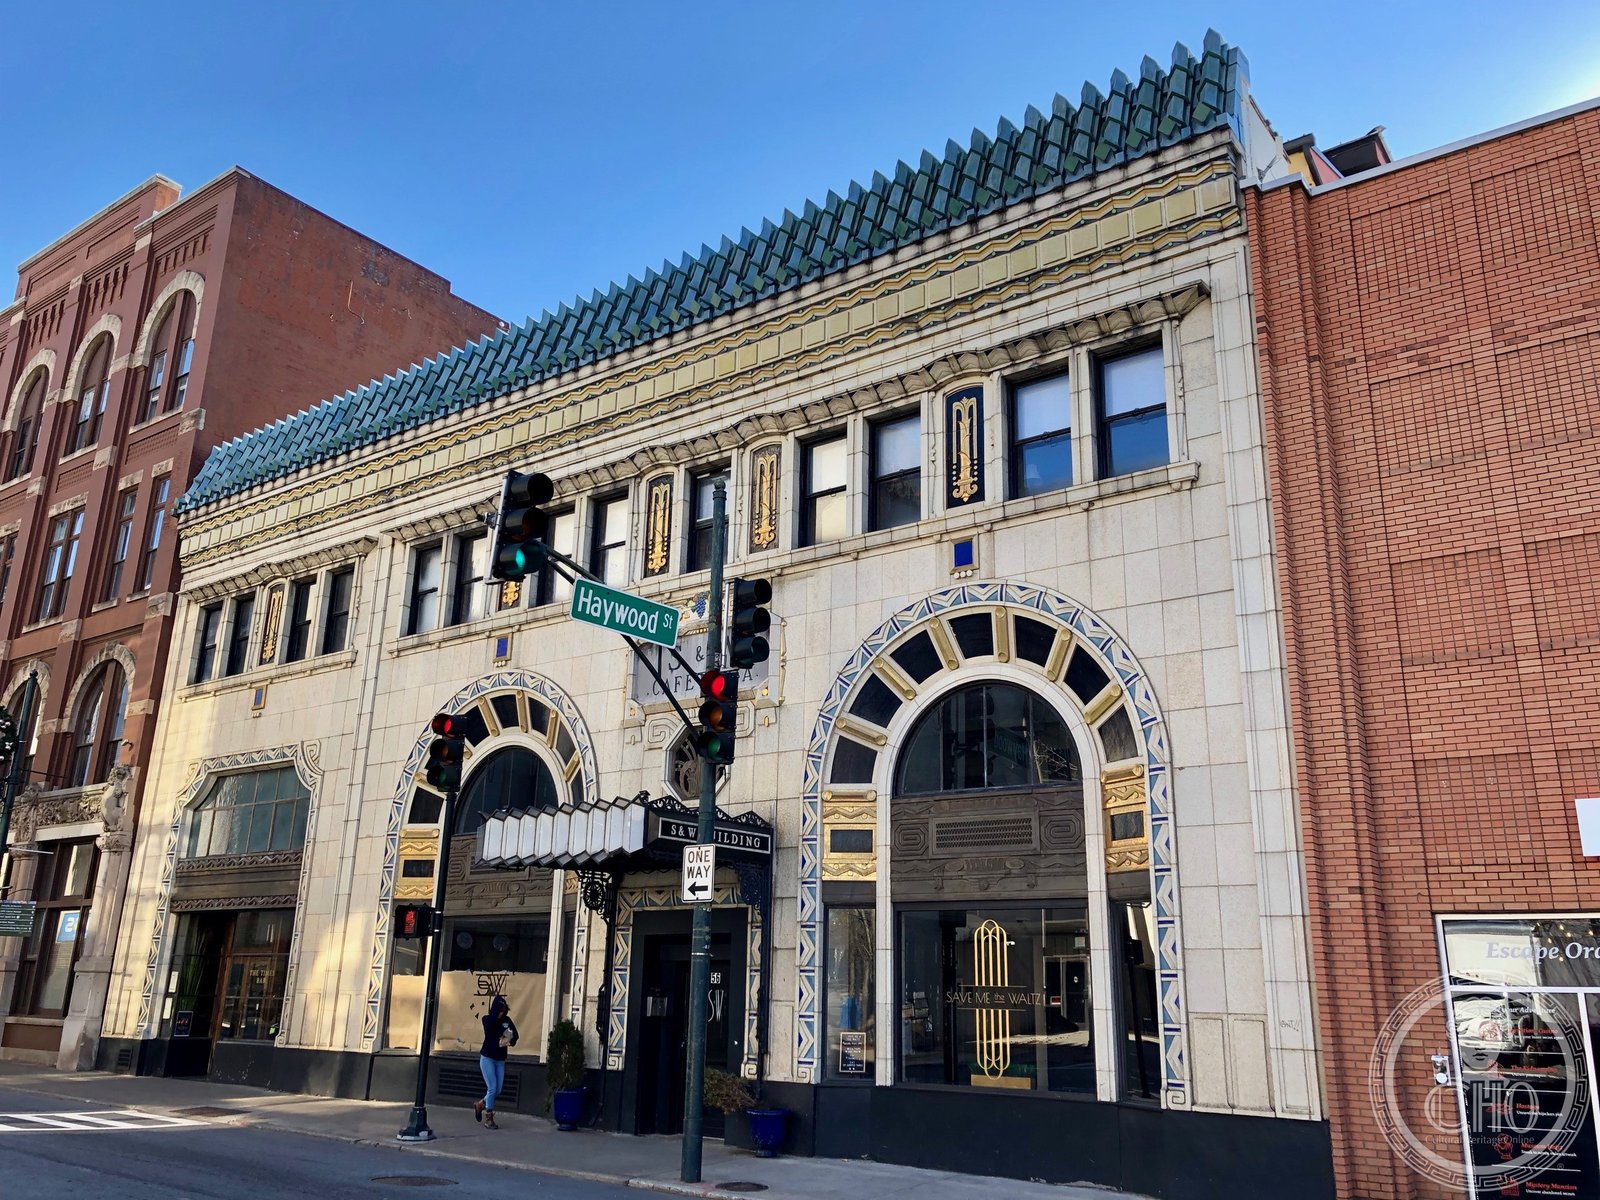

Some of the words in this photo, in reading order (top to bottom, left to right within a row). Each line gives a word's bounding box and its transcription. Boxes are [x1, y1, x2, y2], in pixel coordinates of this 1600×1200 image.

[577, 587, 659, 634] Haywood
[663, 613, 673, 629] St
[713, 830, 761, 848] ILDING
[687, 849, 711, 863] ONE
[687, 865, 711, 879] WAY
[1486, 942, 1559, 965] Escape
[946, 991, 972, 1004] SAVE
[975, 992, 990, 1004] ME
[994, 993, 1005, 1001] the
[1008, 993, 1041, 1006] WALTZ
